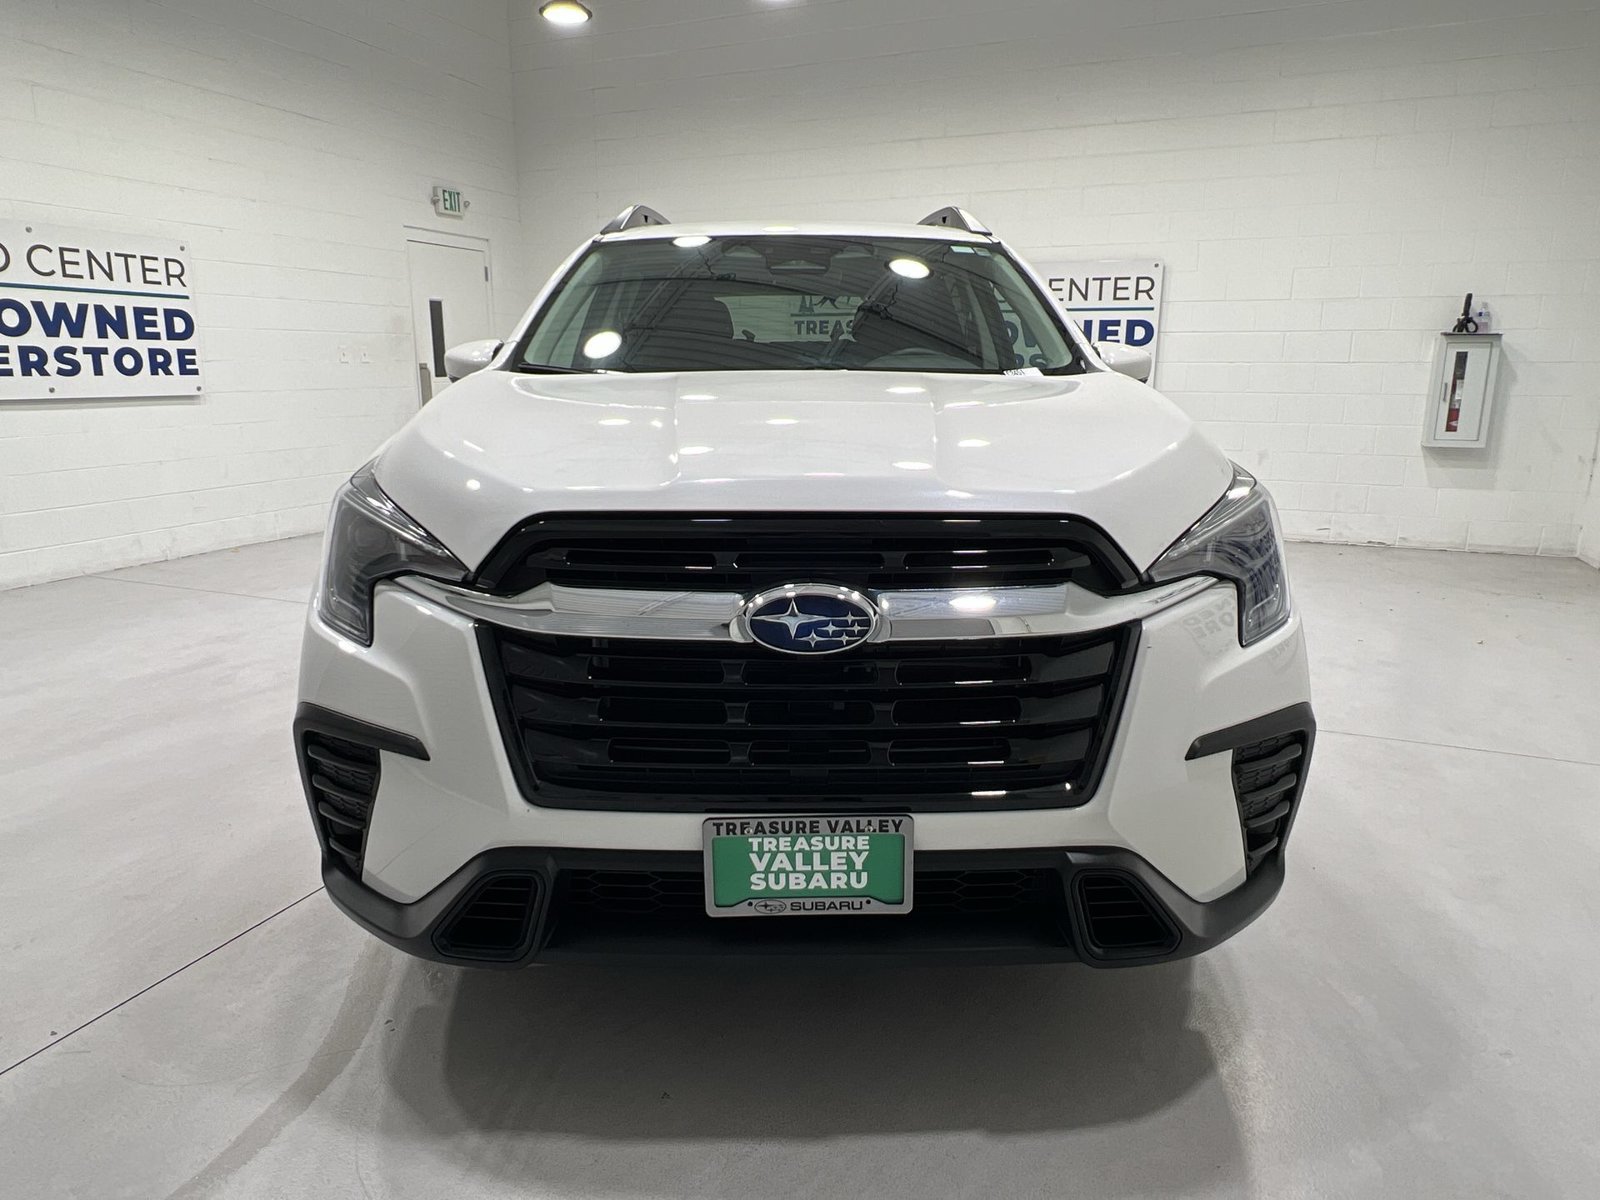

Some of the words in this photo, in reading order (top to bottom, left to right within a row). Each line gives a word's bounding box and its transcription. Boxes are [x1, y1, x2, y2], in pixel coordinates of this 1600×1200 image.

[442, 189, 460, 212] EXIT
[26, 244, 187, 288] CENTER
[1048, 276, 1155, 302] ENTER
[0, 298, 195, 341] OWNED
[794, 320, 854, 335] TREAS
[0, 345, 200, 377] ERSTORE
[712, 819, 820, 836] TREASURE
[826, 819, 903, 834] VALLEY
[748, 835, 870, 852] TREASURE
[748, 851, 869, 872] VALLEY
[750, 871, 868, 890] SUBARU
[790, 900, 863, 911] SUBARU
